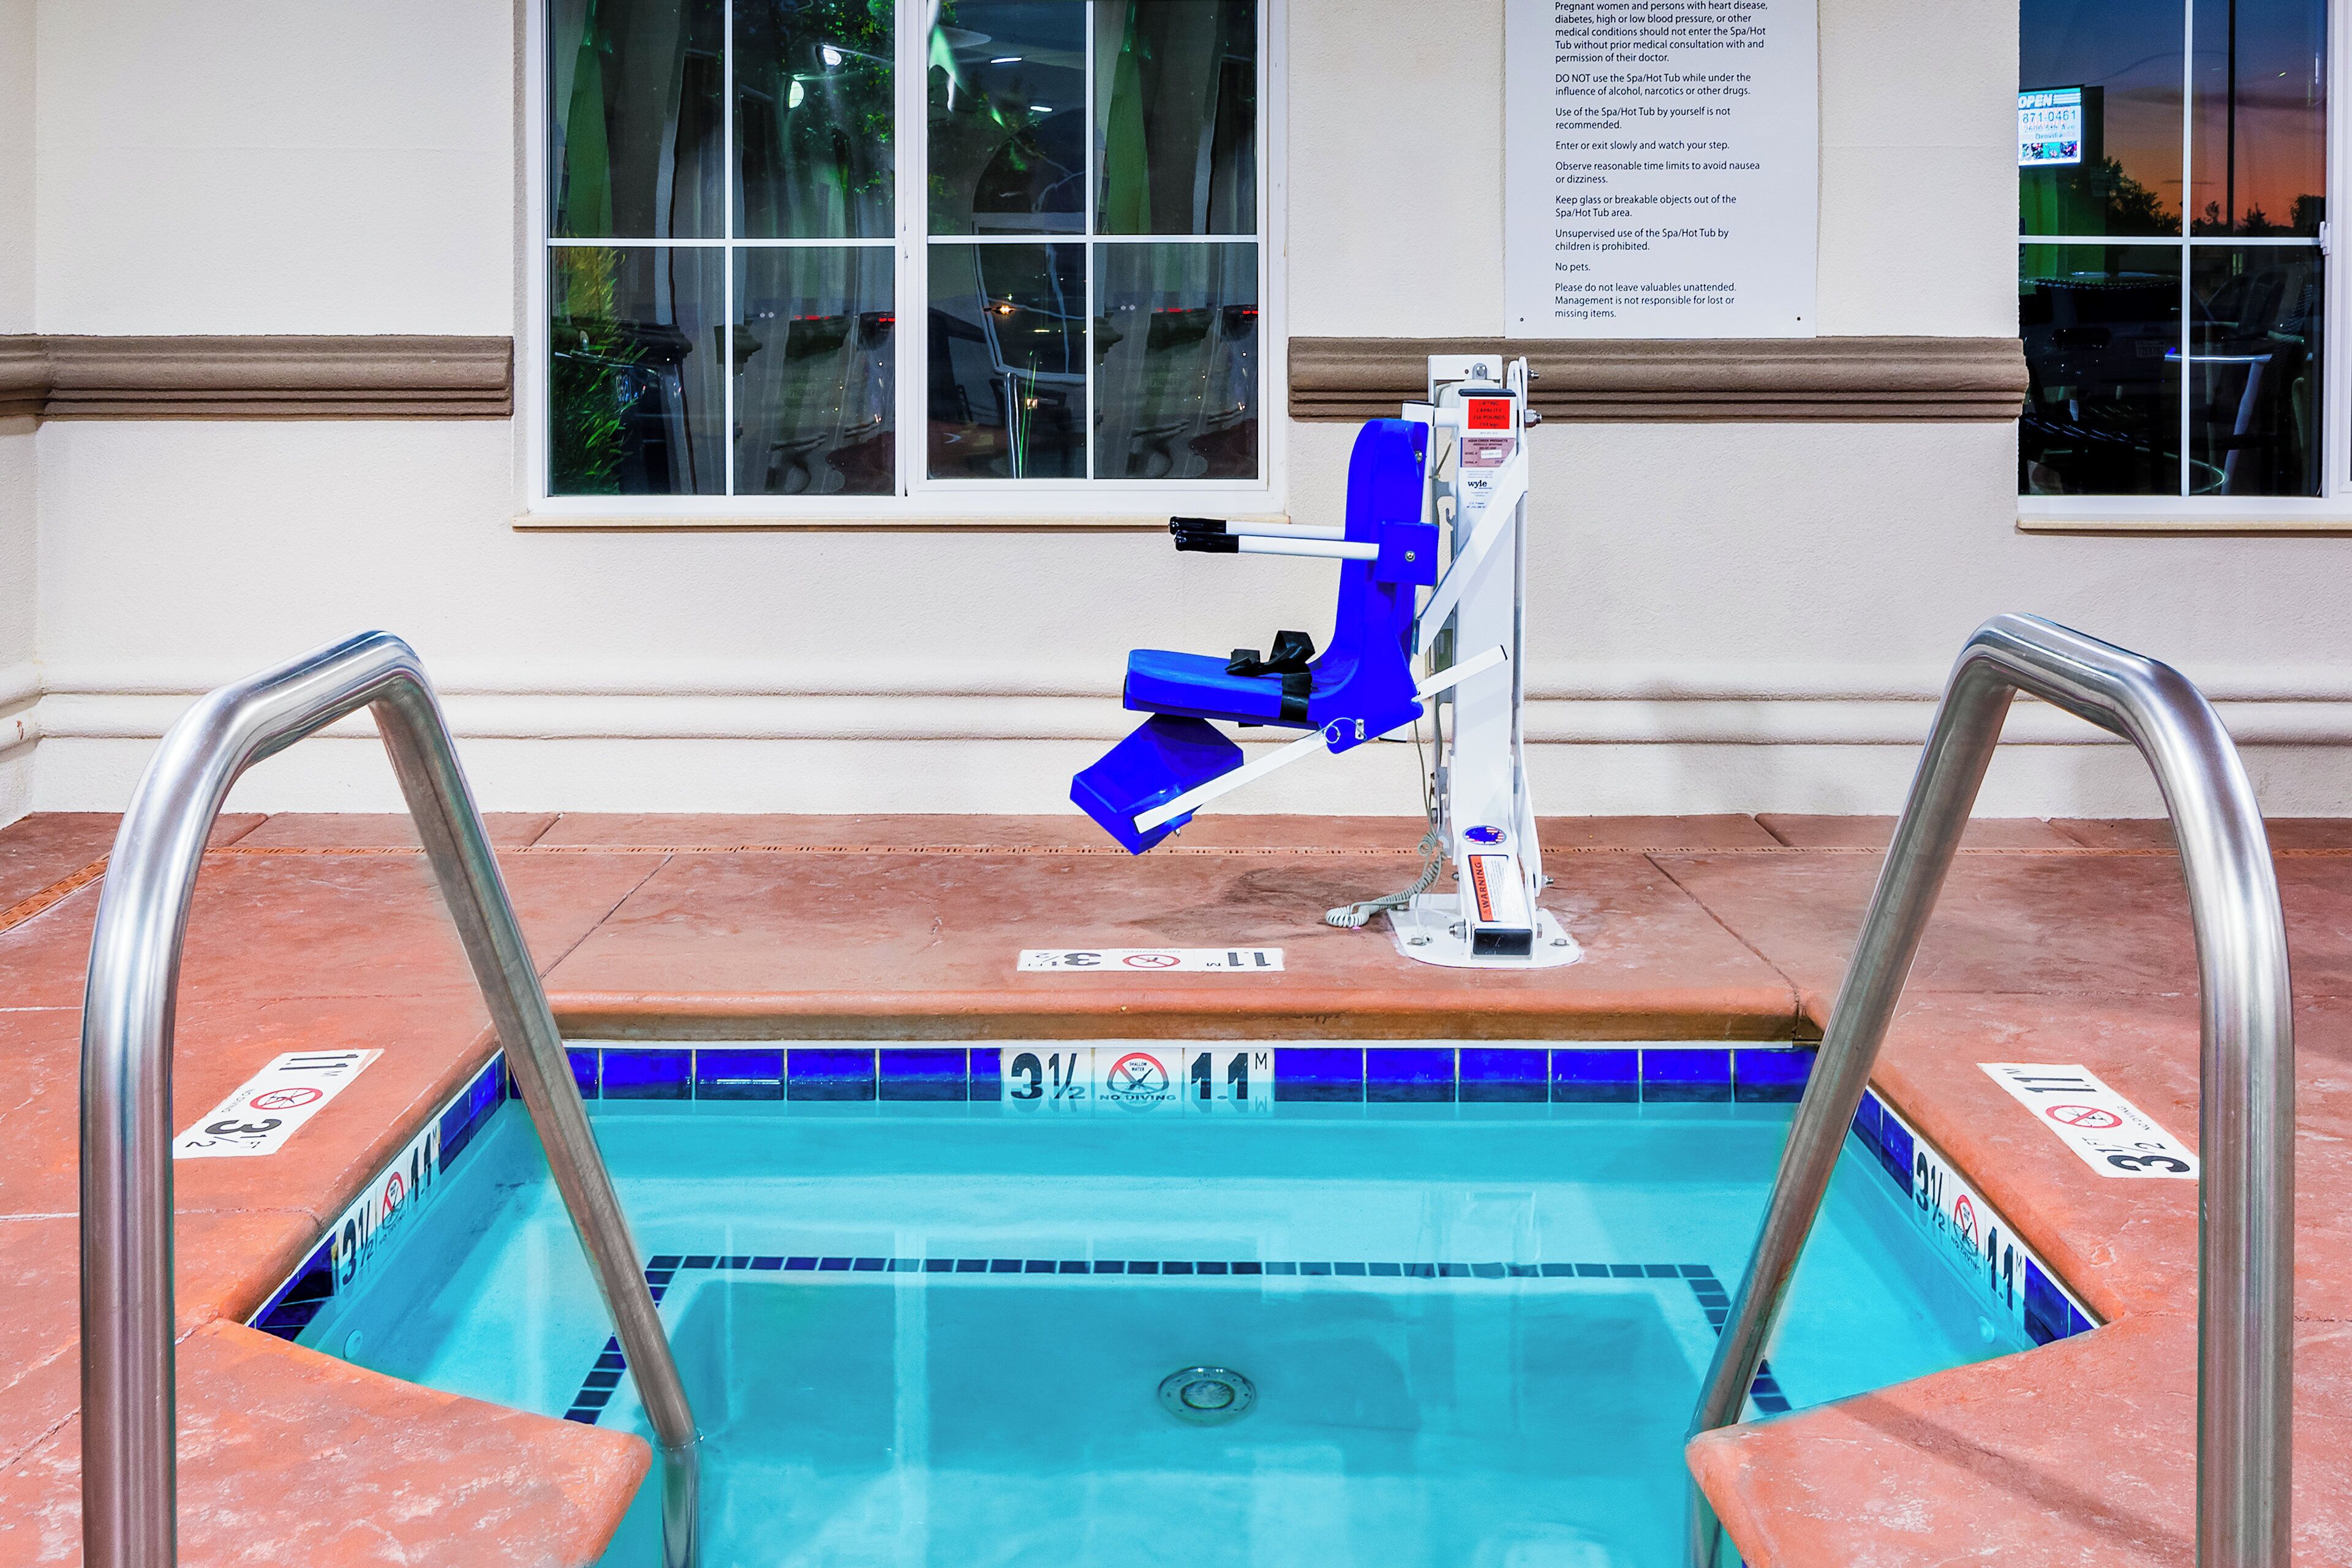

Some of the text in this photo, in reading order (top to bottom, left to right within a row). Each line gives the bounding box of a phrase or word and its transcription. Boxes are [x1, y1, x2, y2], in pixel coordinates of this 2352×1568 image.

[1555, 1, 1594, 13] Pregnant
[1631, 1, 1648, 10] and
[1650, 2, 1685, 12] persons
[1686, 0, 1706, 10] with
[1708, 0, 1732, 10] heart
[1733, 0, 1768, 10] disease,
[1555, 14, 1594, 24] diabetes,
[1596, 13, 1616, 26] high
[1629, 13, 1646, 23] low
[1647, 13, 1673, 23] blood
[1675, 15, 1714, 25] pressure,
[1727, 13, 1752, 23] other
[1555, 26, 1766, 37] medical conditions should not enter the Spa/Hot
[1555, 39, 1764, 51] Tub without prior medical consultation with and
[1555, 52, 1670, 64] permission of their doctor.
[1555, 74, 1570, 83] DO
[1572, 74, 1591, 83] NOT
[1610, 73, 1624, 83] the
[1626, 73, 1662, 85] Spa/Hot
[1663, 73, 1681, 83] Tub
[1682, 73, 1706, 82] while
[1708, 72, 1735, 82] under
[1736, 72, 1751, 82] the
[1555, 86, 1596, 96] influence
[1597, 86, 1607, 96] of
[1608, 86, 1643, 96] alcohol,
[1645, 86, 1684, 96] narcotics
[1697, 85, 1721, 95] other
[1722, 85, 1751, 97] drugs.
[2018, 93, 2053, 108] OPEN
[1555, 107, 1572, 116] Use
[1574, 107, 1583, 116] of
[1585, 107, 1599, 116] the
[1601, 107, 1637, 118] Spa/Hot
[1638, 107, 1655, 116] Tub
[1657, 107, 1668, 118] by
[1670, 106, 1705, 118] yourself
[1706, 107, 1714, 116] is
[2022, 110, 2076, 123] 871-0461
[1555, 119, 1622, 129] recommended.
[1556, 140, 1579, 150] Enter
[1591, 140, 1608, 150] exit
[1610, 140, 1638, 152] slowly
[1639, 140, 1656, 149] and
[1658, 140, 1685, 149] watch
[1686, 142, 1707, 152] your
[1709, 141, 1730, 151] step.
[1555, 161, 1592, 171] Observe
[1594, 160, 1642, 170] reasonable
[1643, 161, 1664, 170] time
[1666, 160, 1690, 170] limits
[1691, 162, 1701, 170] to
[1703, 160, 1727, 170] avoid
[1566, 174, 1608, 184] dizziness.
[1555, 195, 1578, 206] Keep
[1579, 194, 1602, 206] glass
[1615, 194, 1658, 204] breakable
[1659, 194, 1692, 206] objects
[1694, 195, 1709, 204] out
[1711, 194, 1721, 204] of
[1722, 194, 1736, 204] the
[1555, 208, 1591, 219] Spa/Hot
[1593, 208, 1610, 217] Tub
[1555, 228, 1615, 239] Unsupervised
[1634, 228, 1644, 238] of
[1645, 228, 1660, 238] the
[1662, 228, 1698, 239] Spa/Hot
[1698, 228, 1716, 238] Tub
[1717, 228, 1729, 239] by
[1555, 241, 1650, 253] children is prohibited.
[1555, 262, 1591, 273] No pets.
[1555, 282, 1583, 292] Please
[1585, 282, 1597, 292] do
[1615, 282, 1638, 292] leave
[1640, 282, 1681, 292] valuables
[1683, 282, 1736, 292] unattended.
[1555, 296, 1613, 307] Management
[1624, 296, 1639, 305] not
[1641, 295, 1692, 307] responsible
[1693, 295, 1706, 304] for
[1707, 295, 1723, 304] lost
[1555, 309, 1588, 320] missing
[1468, 480, 1487, 489] wyle
[1474, 862, 1490, 908] WARNING
